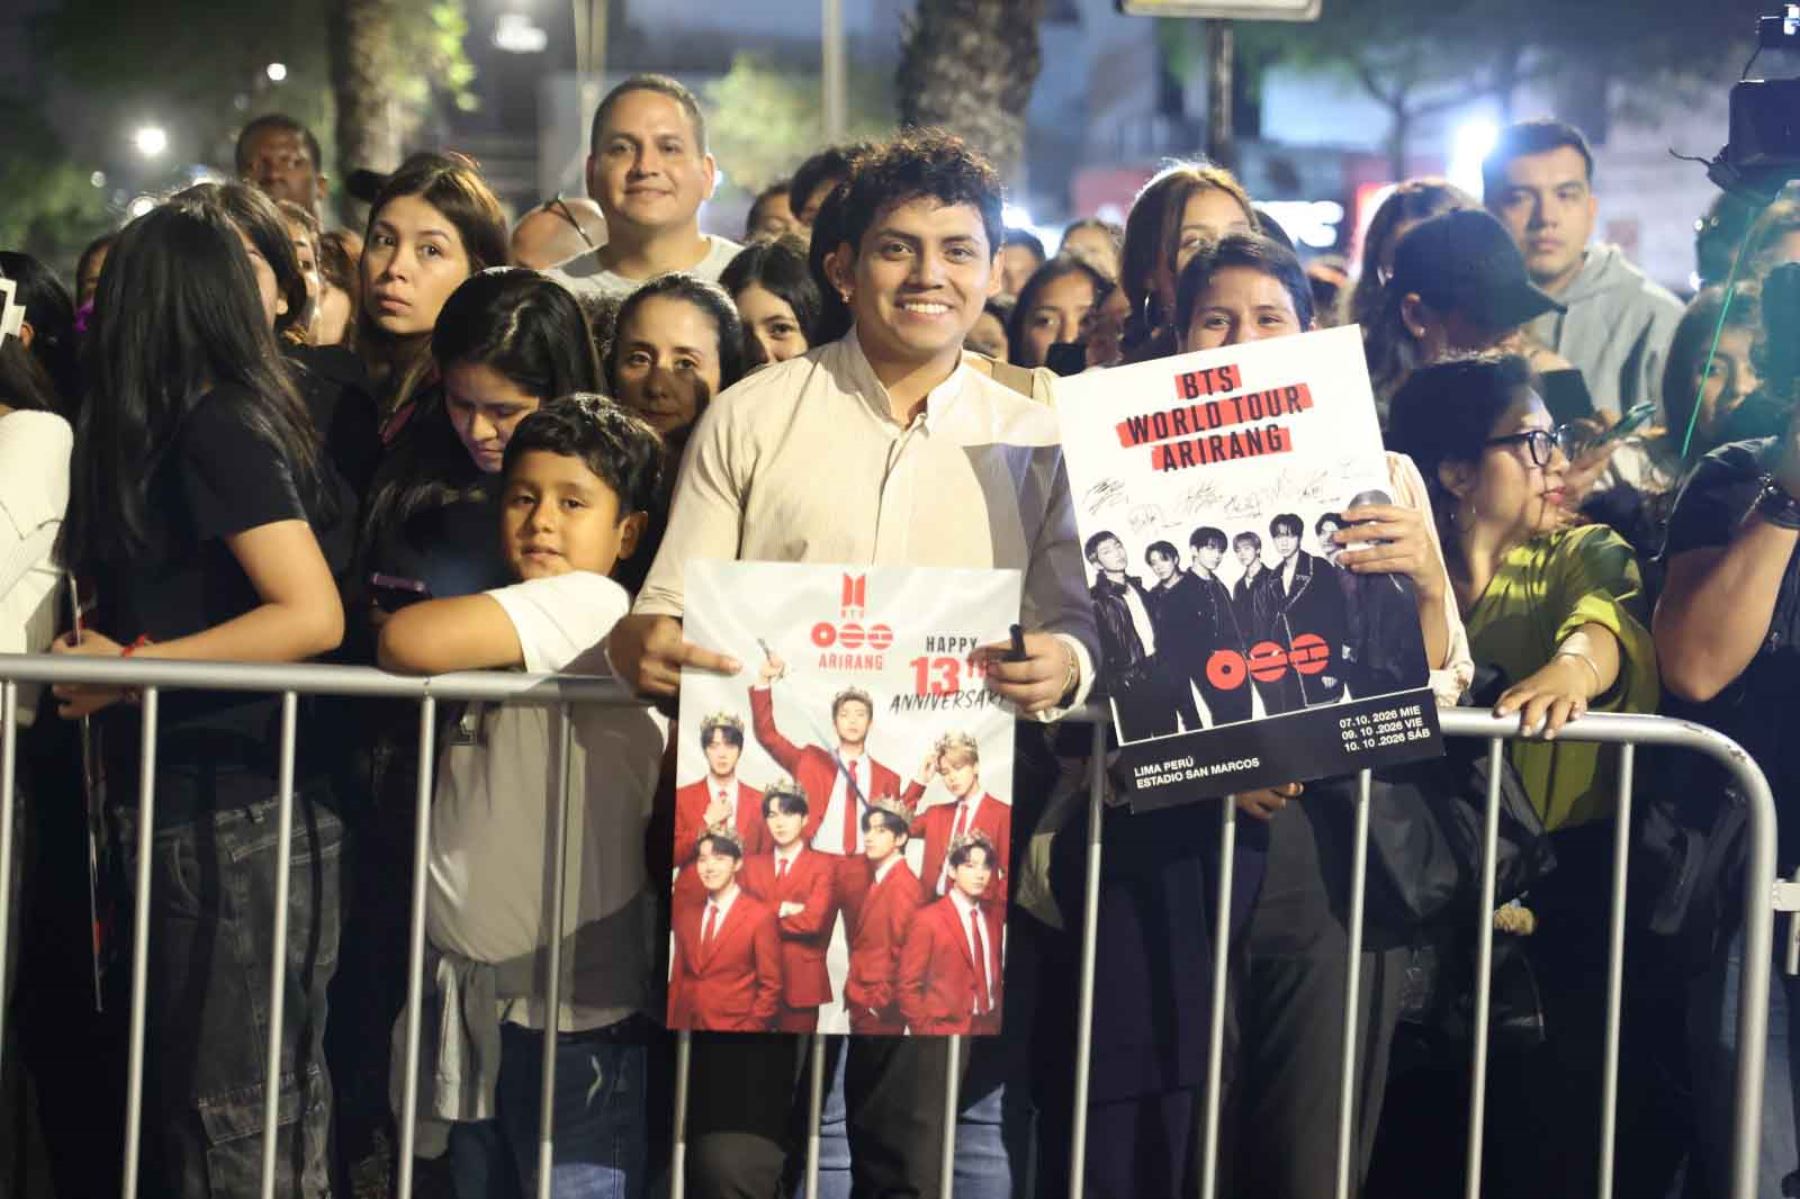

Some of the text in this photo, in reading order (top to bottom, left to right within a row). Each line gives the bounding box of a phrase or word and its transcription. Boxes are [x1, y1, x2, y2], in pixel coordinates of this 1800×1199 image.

[1181, 366, 1234, 400] BTS
[1127, 385, 1303, 445] WORLD TOUR
[1162, 424, 1283, 472] ARIRANG
[926, 636, 978, 653] HAPPY
[819, 652, 883, 672] ARIRANG
[1372, 710, 1398, 723] 2026
[1399, 705, 1421, 718] MIE
[1404, 717, 1423, 728] VIE
[1407, 727, 1431, 740] SÁB
[1134, 755, 1194, 777] LIMA PERÚ
[1136, 757, 1260, 789] ESTADIO SAN MARCOS
